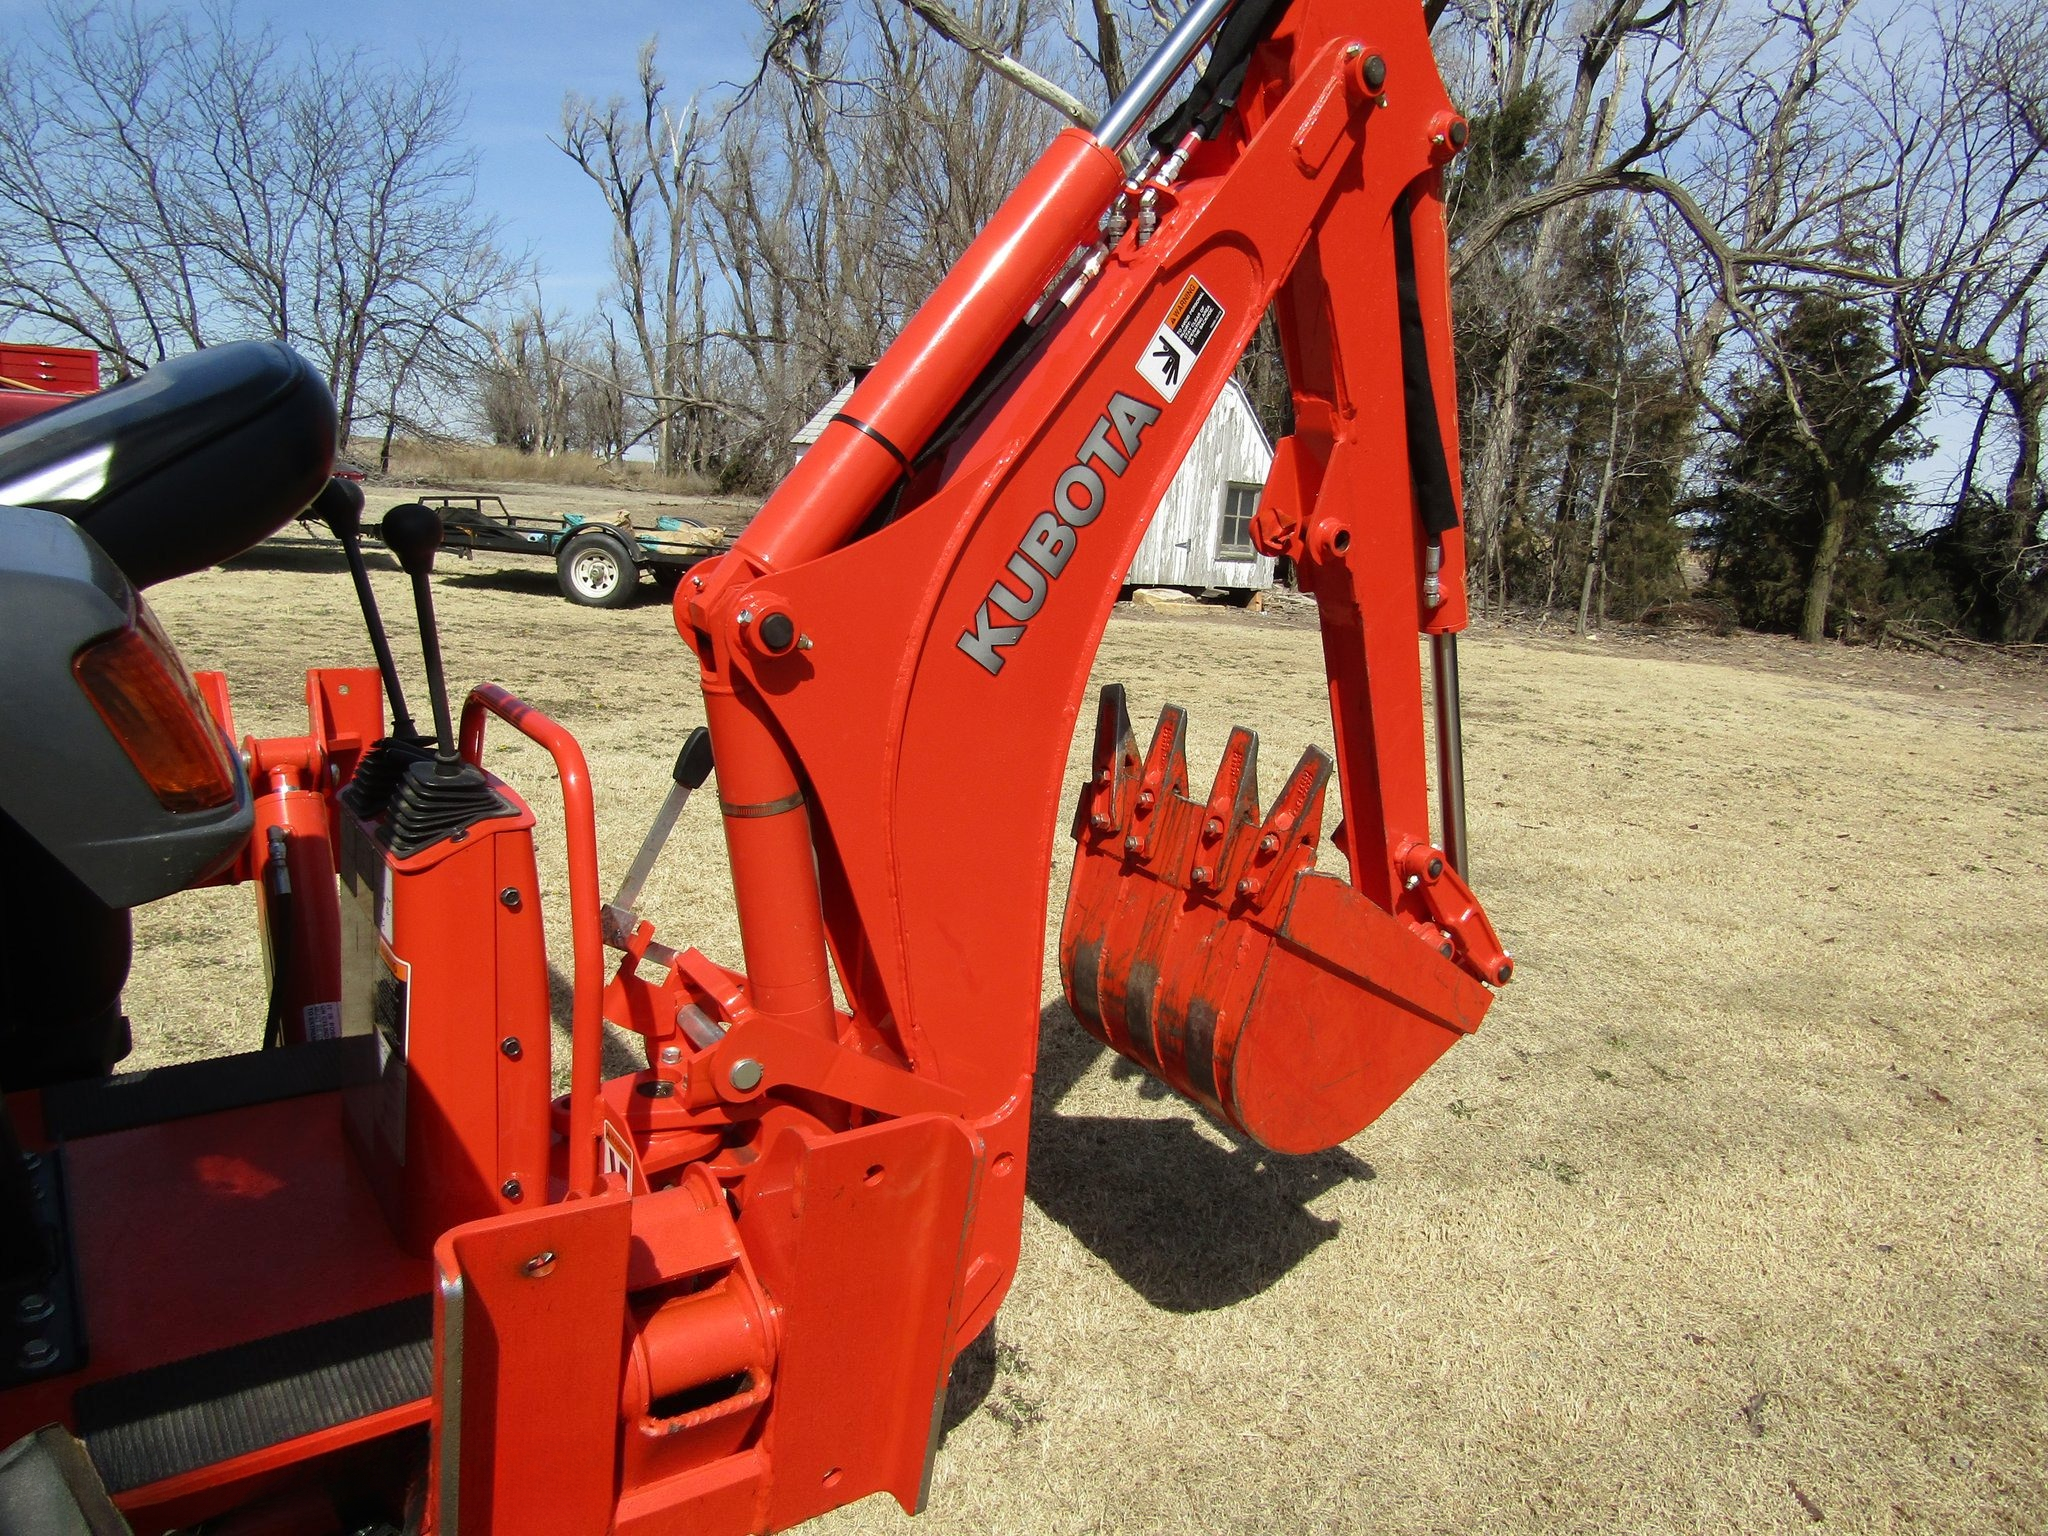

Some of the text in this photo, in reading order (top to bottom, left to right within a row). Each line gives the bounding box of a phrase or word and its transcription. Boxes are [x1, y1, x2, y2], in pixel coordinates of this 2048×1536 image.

[1174, 283, 1195, 318] WARNING
[1201, 303, 1210, 317] AREA
[1180, 313, 1190, 329] AVOID
[1183, 326, 1192, 339] STAY
[1190, 311, 1201, 327] CLEAR
[956, 391, 1162, 676] KUBOTA
